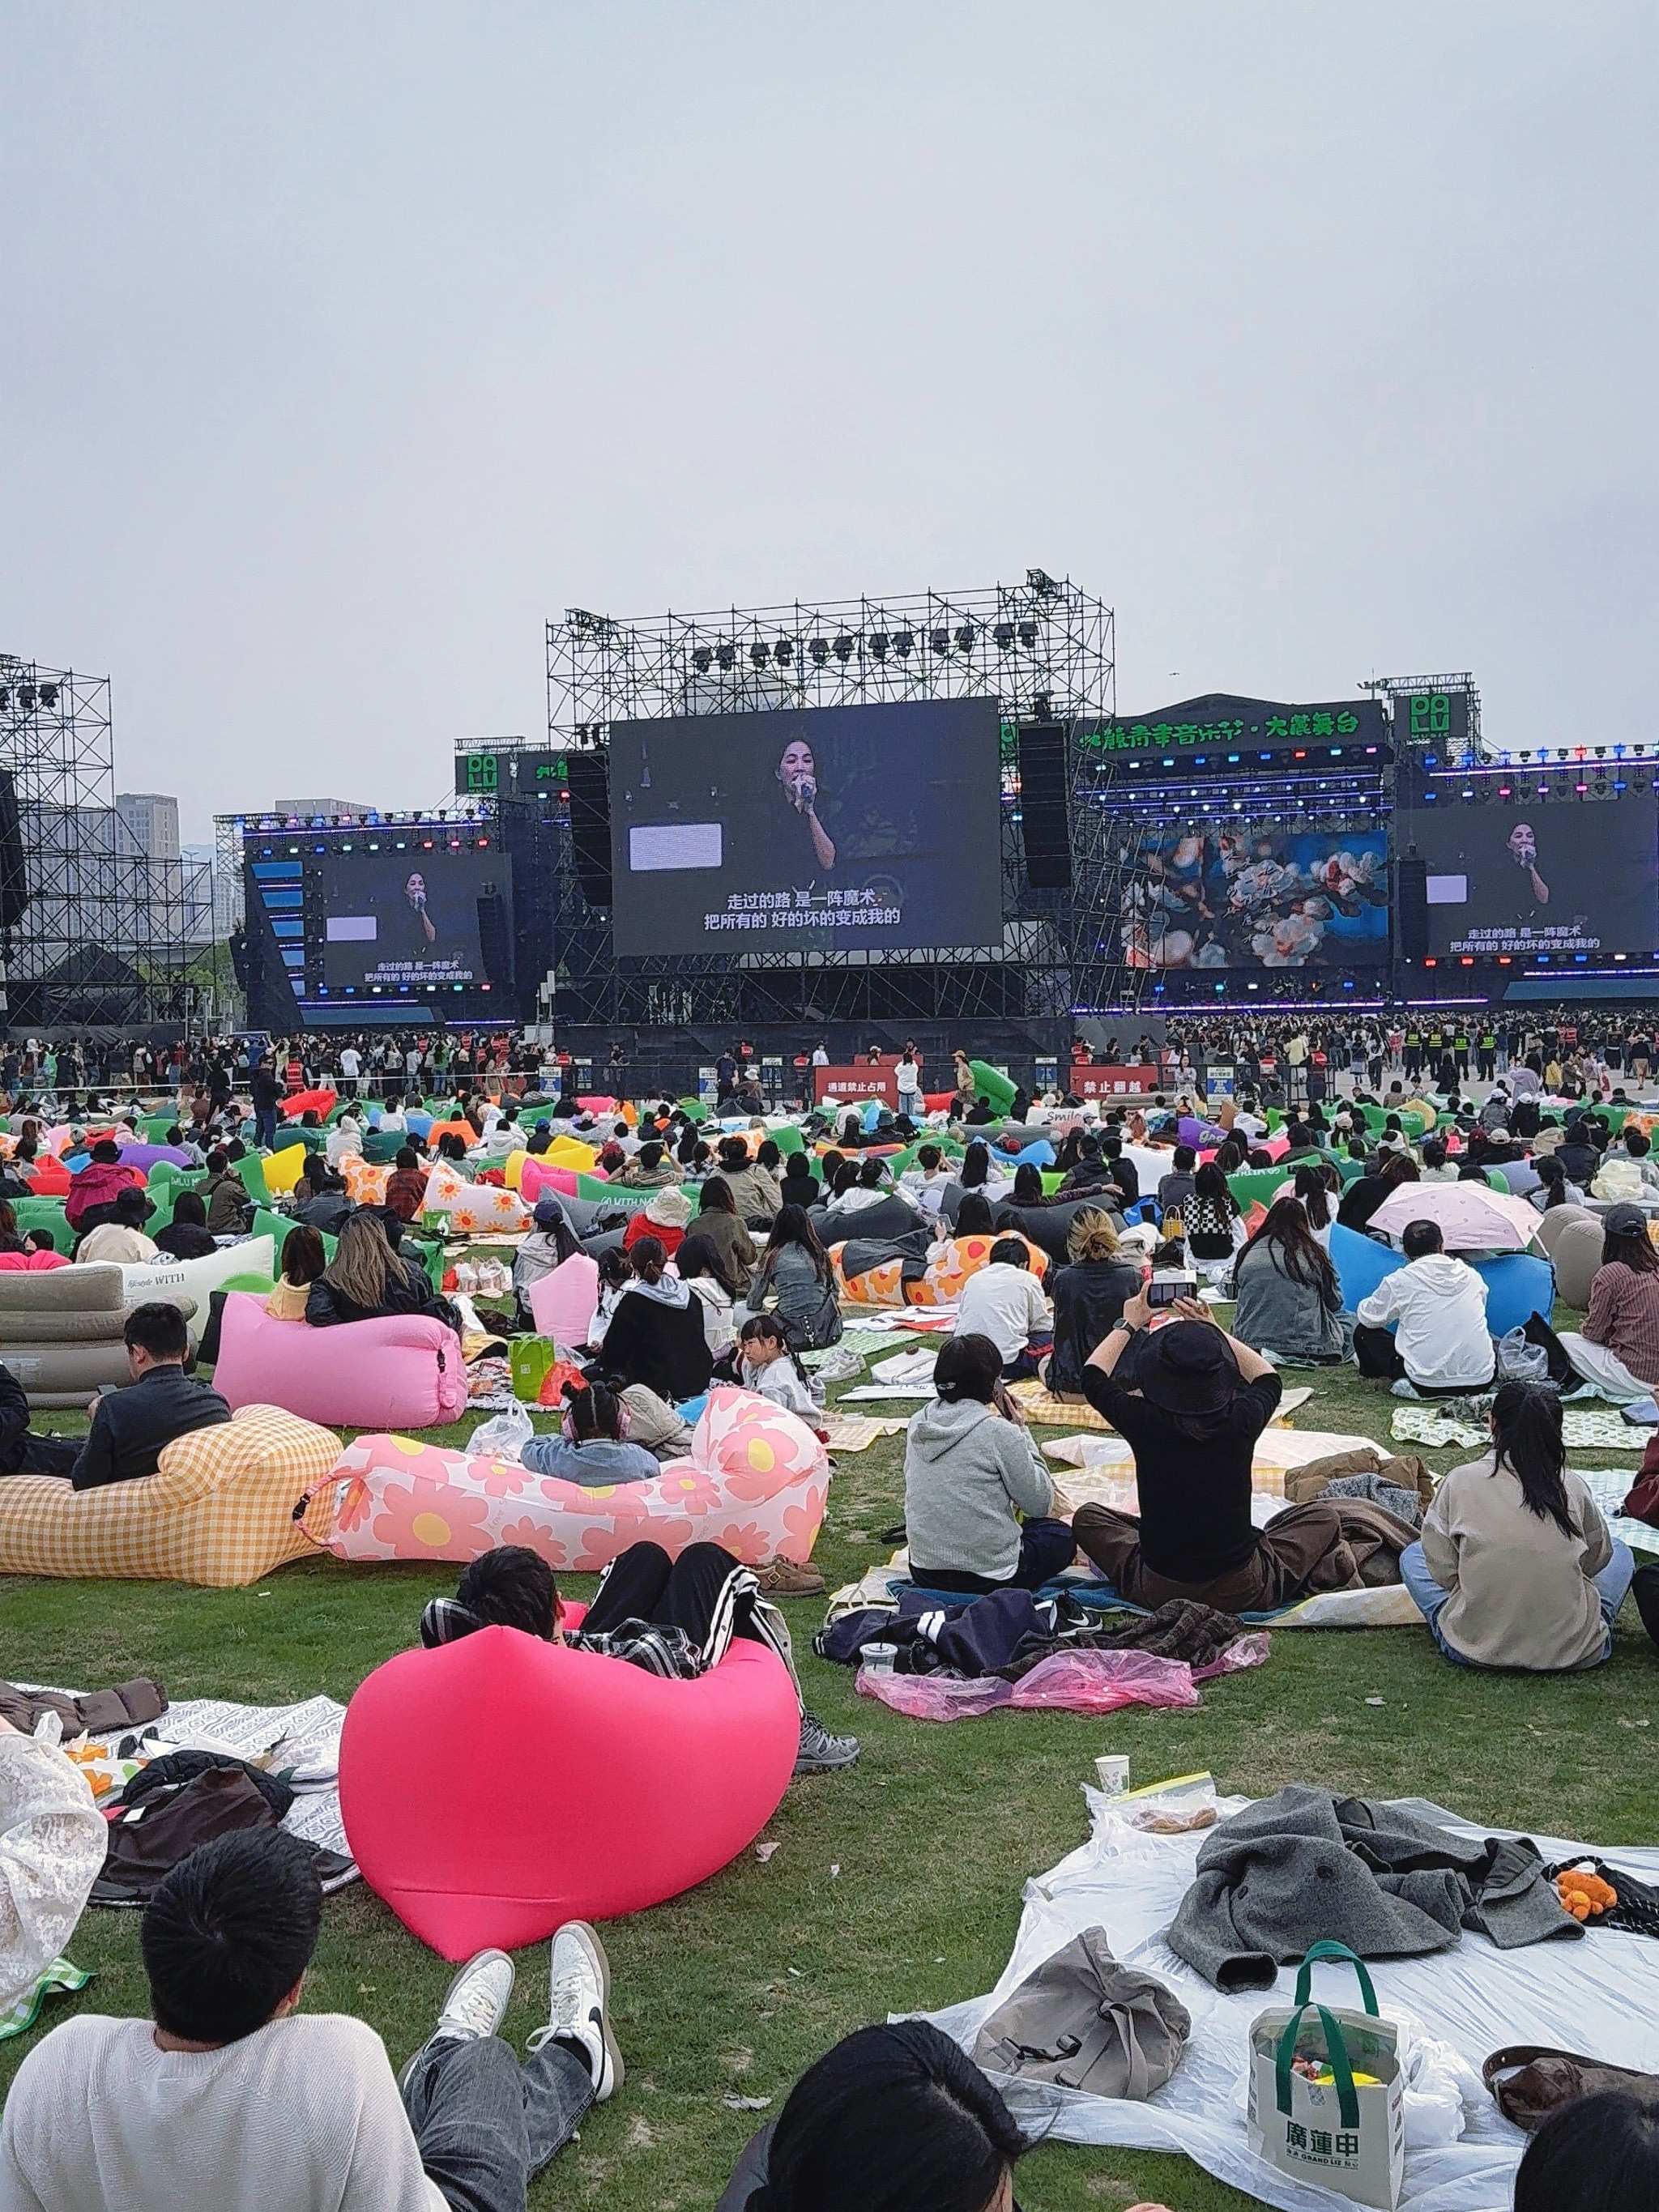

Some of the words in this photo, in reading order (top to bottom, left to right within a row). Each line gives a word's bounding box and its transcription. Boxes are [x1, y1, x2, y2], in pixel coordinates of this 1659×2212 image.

[727, 892, 791, 910] 走过的路
[795, 889, 876, 908] 是一阵魔术
[704, 912, 767, 930] 把所有的
[771, 907, 901, 927] 好的坏的变成我的
[1467, 927, 1516, 940] 走过的路
[1520, 926, 1582, 938] 是一阵魔术
[1449, 940, 1499, 953] 把所有的
[1501, 937, 1601, 951] 好的坏的变成我的
[377, 961, 413, 971] 走过的路
[365, 972, 399, 982] 把所有的
[828, 1081, 886, 1093] 通道禁止占用
[1084, 1080, 1142, 1094] 禁止翻越
[155, 1272, 186, 1285] WITH
[1286, 2120, 1359, 2158] 廣蓮申
[1301, 2154, 1329, 2164] GRAND
[1330, 2158, 1342, 2166] LIZ
